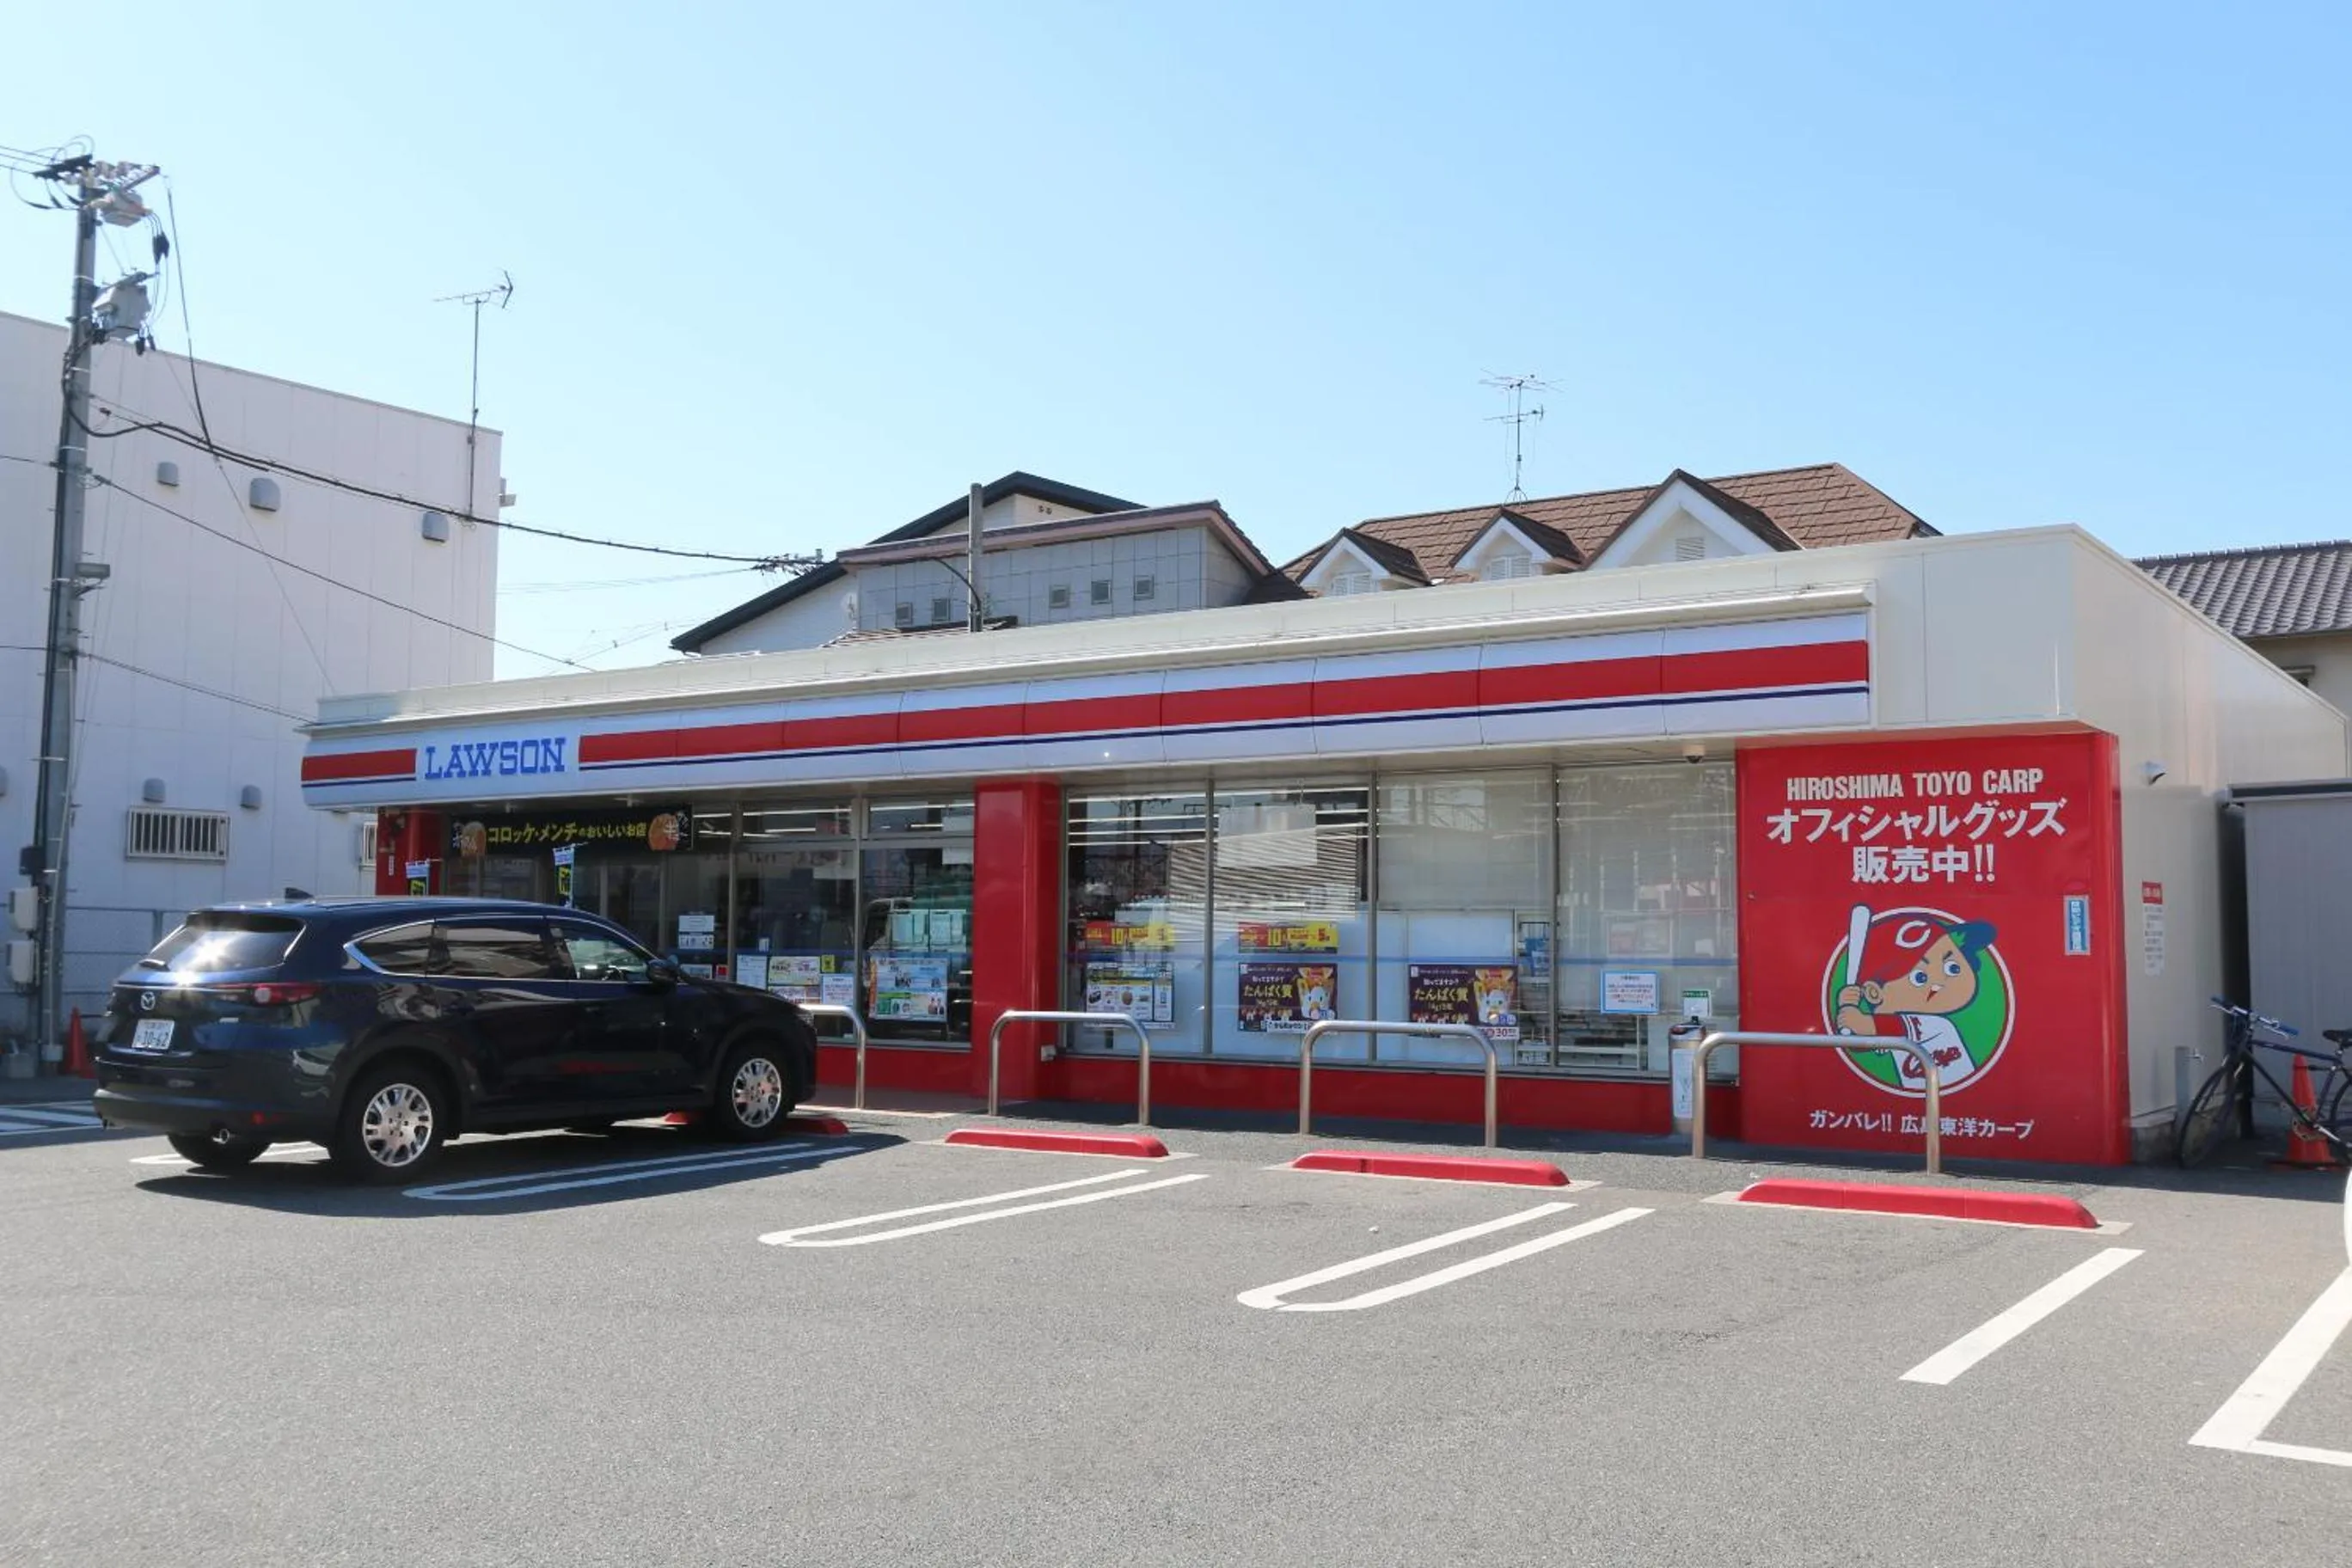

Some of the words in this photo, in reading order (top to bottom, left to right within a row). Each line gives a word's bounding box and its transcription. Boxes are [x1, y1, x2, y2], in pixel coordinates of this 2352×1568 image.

[425, 738, 567, 780] LAWSON
[1786, 774, 1904, 801] HIROSHIMA
[1913, 771, 1972, 797] TOYO
[1982, 768, 2043, 794] CARP
[1767, 797, 2067, 844] オフィシャルグッズ
[1851, 843, 1995, 884] 販売中!!
[1809, 1109, 1892, 1133] ガンバレ!!
